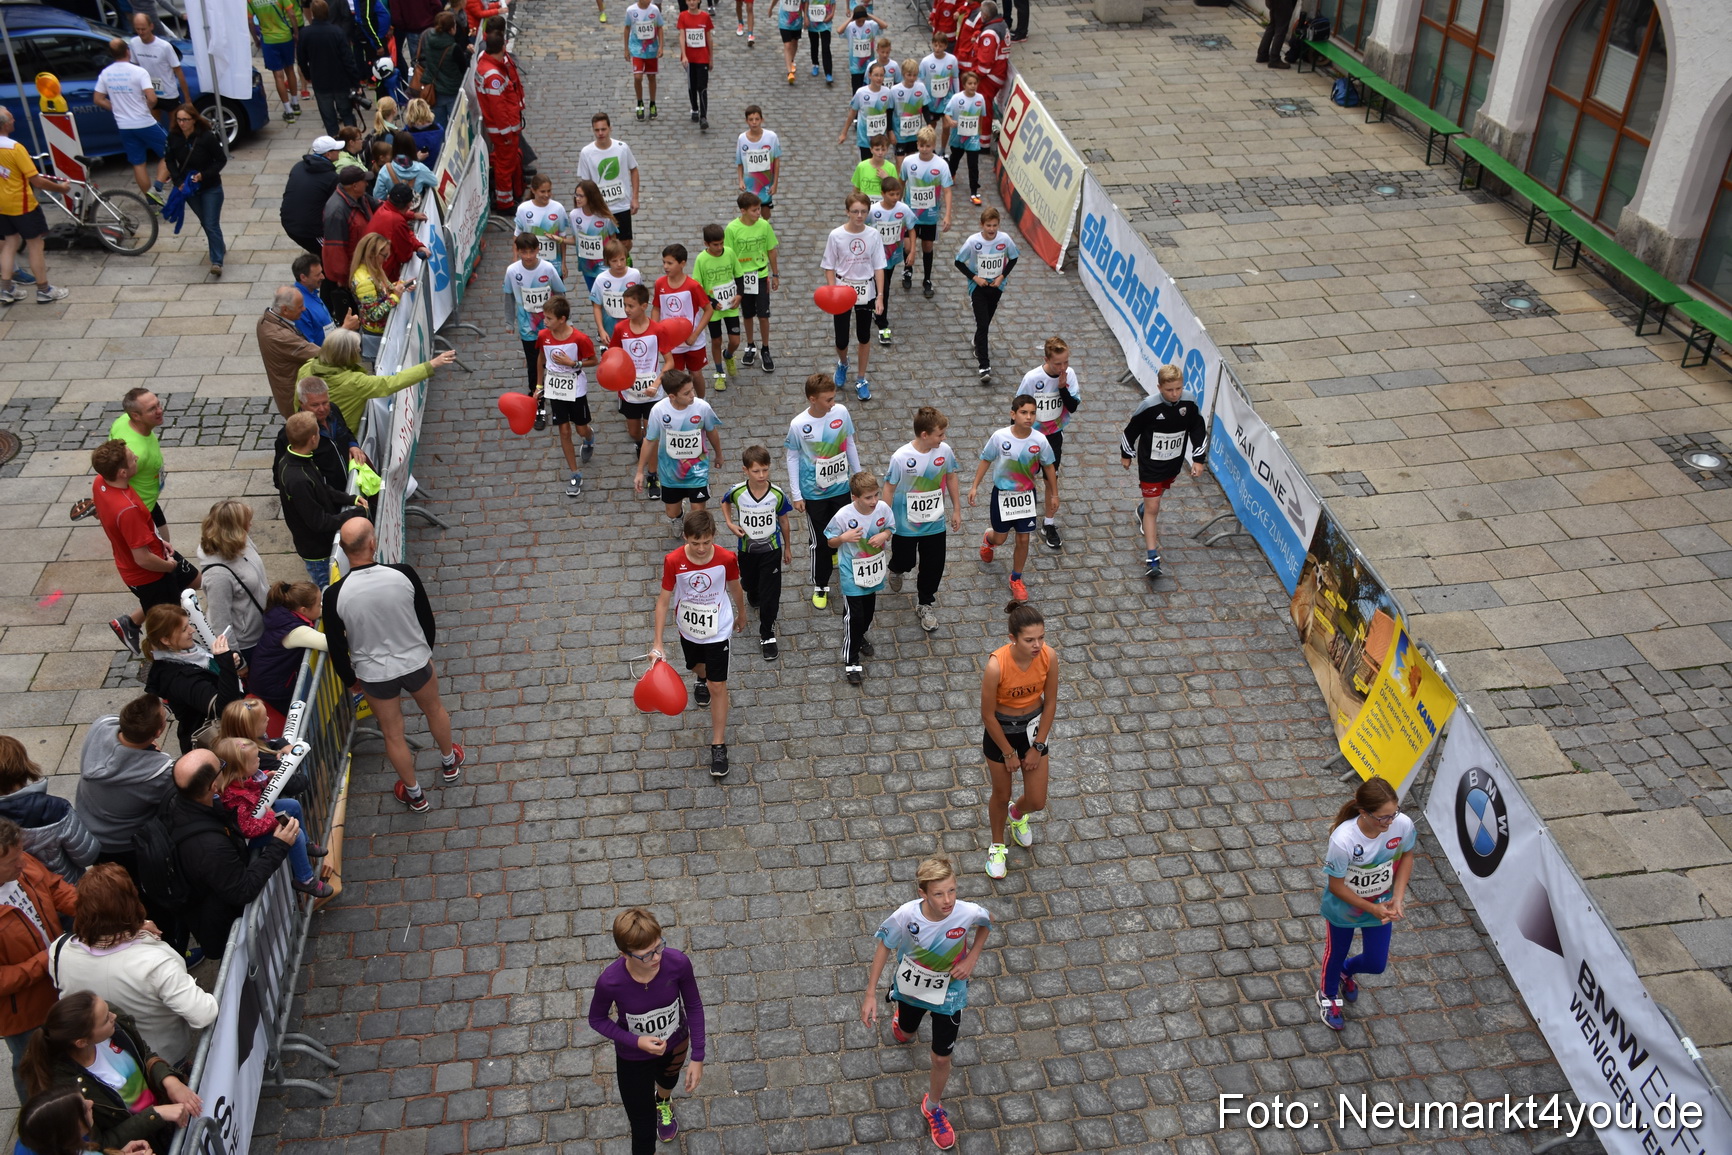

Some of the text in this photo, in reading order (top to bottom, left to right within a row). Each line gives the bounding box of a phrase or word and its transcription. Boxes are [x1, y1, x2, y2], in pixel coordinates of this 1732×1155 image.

[960, 120, 977, 129] 4104
[749, 154, 768, 163] 4004
[602, 186, 622, 197] 4109
[913, 191, 933, 201] 4030
[1007, 152, 1059, 233] PFLASTERSTEINE
[880, 226, 900, 236] 4117
[580, 240, 600, 250] 4046
[981, 259, 1002, 269] 4000
[526, 293, 549, 304] 4014
[718, 286, 736, 301] 4047
[549, 377, 573, 390] 4028
[1037, 398, 1062, 410] 4106
[670, 437, 698, 448] 4022
[1156, 438, 1182, 450] 4100
[820, 460, 845, 477] 4005
[911, 497, 940, 511] 4027
[1003, 495, 1031, 508] 4009
[744, 514, 773, 528] 4036
[1268, 520, 1300, 579] ZUHAUSE
[858, 560, 883, 577] 4101
[683, 610, 713, 628] 4041
[690, 627, 706, 635] Patrick
[1384, 679, 1402, 708] Systeme
[1401, 707, 1410, 722] von
[1380, 688, 1419, 753] Die passen perfekt!
[1416, 700, 1437, 738] KANN
[1366, 715, 1382, 739] Palisaden
[251, 760, 294, 817] bmw-laufspo
[1468, 769, 1509, 838] BMW
[1350, 870, 1390, 887] 4023
[1356, 886, 1382, 895] Luciana
[902, 969, 944, 989] 4113
[634, 1010, 676, 1033] 4002
[1578, 959, 1649, 1072] BMW
[1569, 990, 1636, 1117] WENIGER
